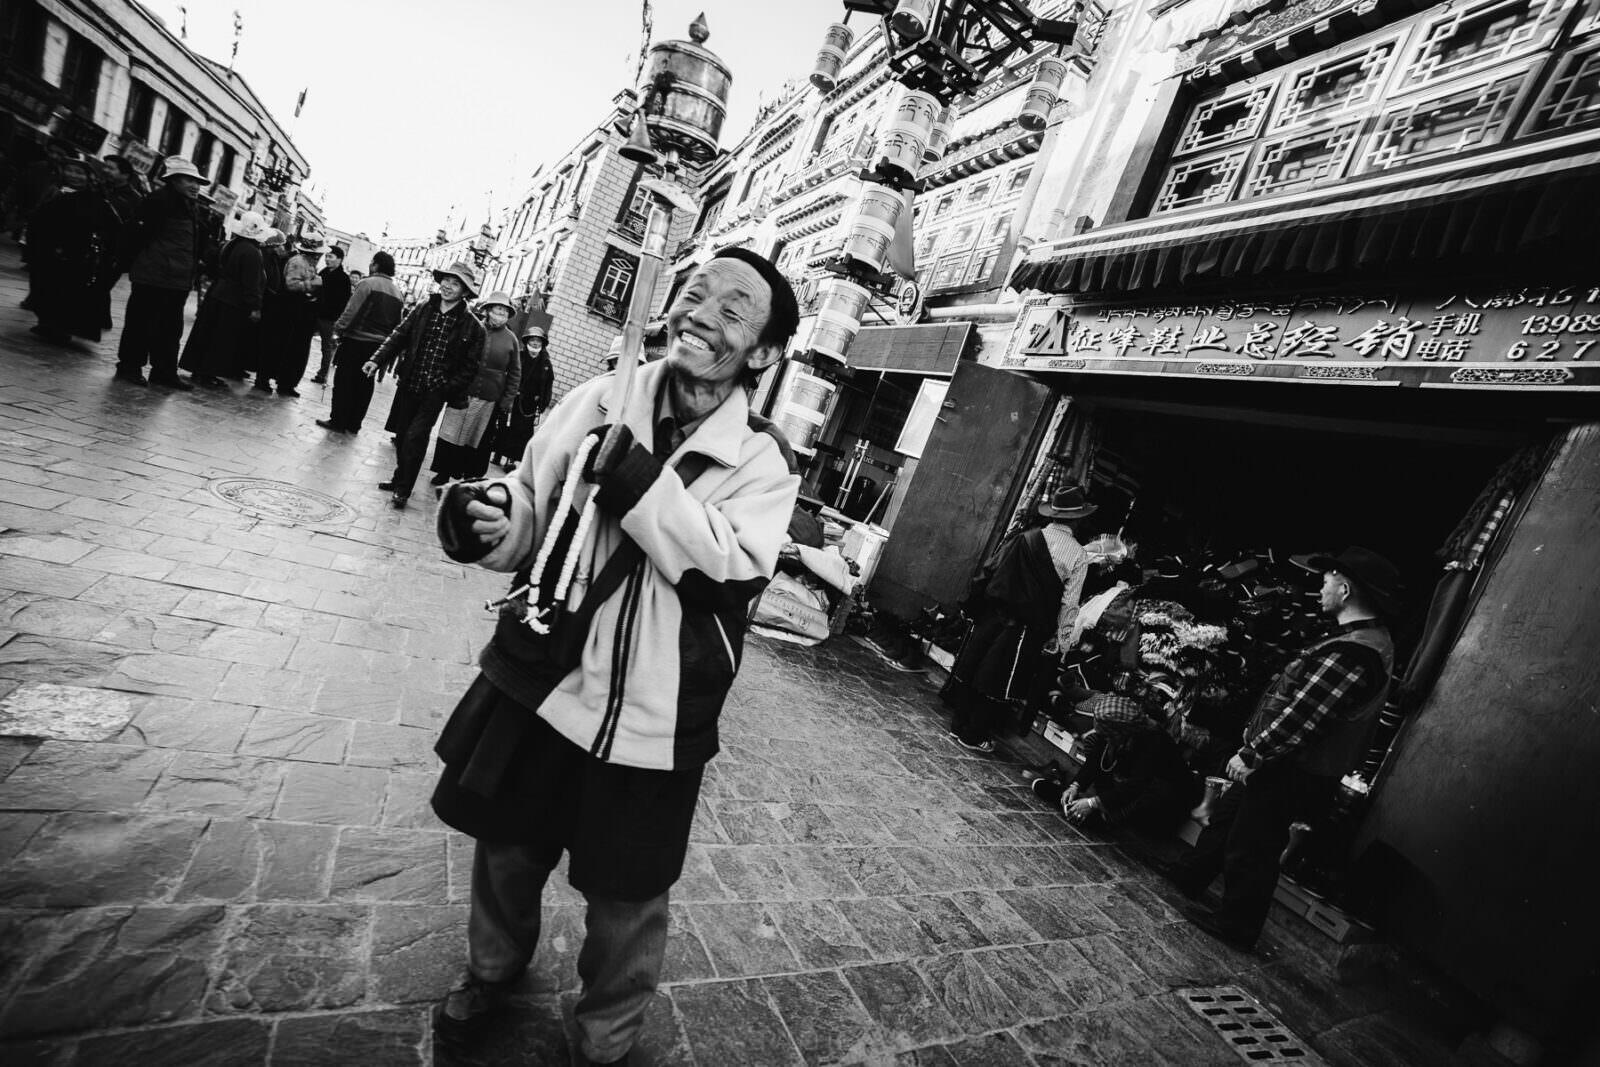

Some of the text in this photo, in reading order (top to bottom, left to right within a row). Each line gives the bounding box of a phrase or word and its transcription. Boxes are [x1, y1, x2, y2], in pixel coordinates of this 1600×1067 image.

[1428, 313, 1482, 336] 手机
[1072, 316, 1423, 360] 征峰鞋业总经销
[1416, 338, 1471, 361] 电话
